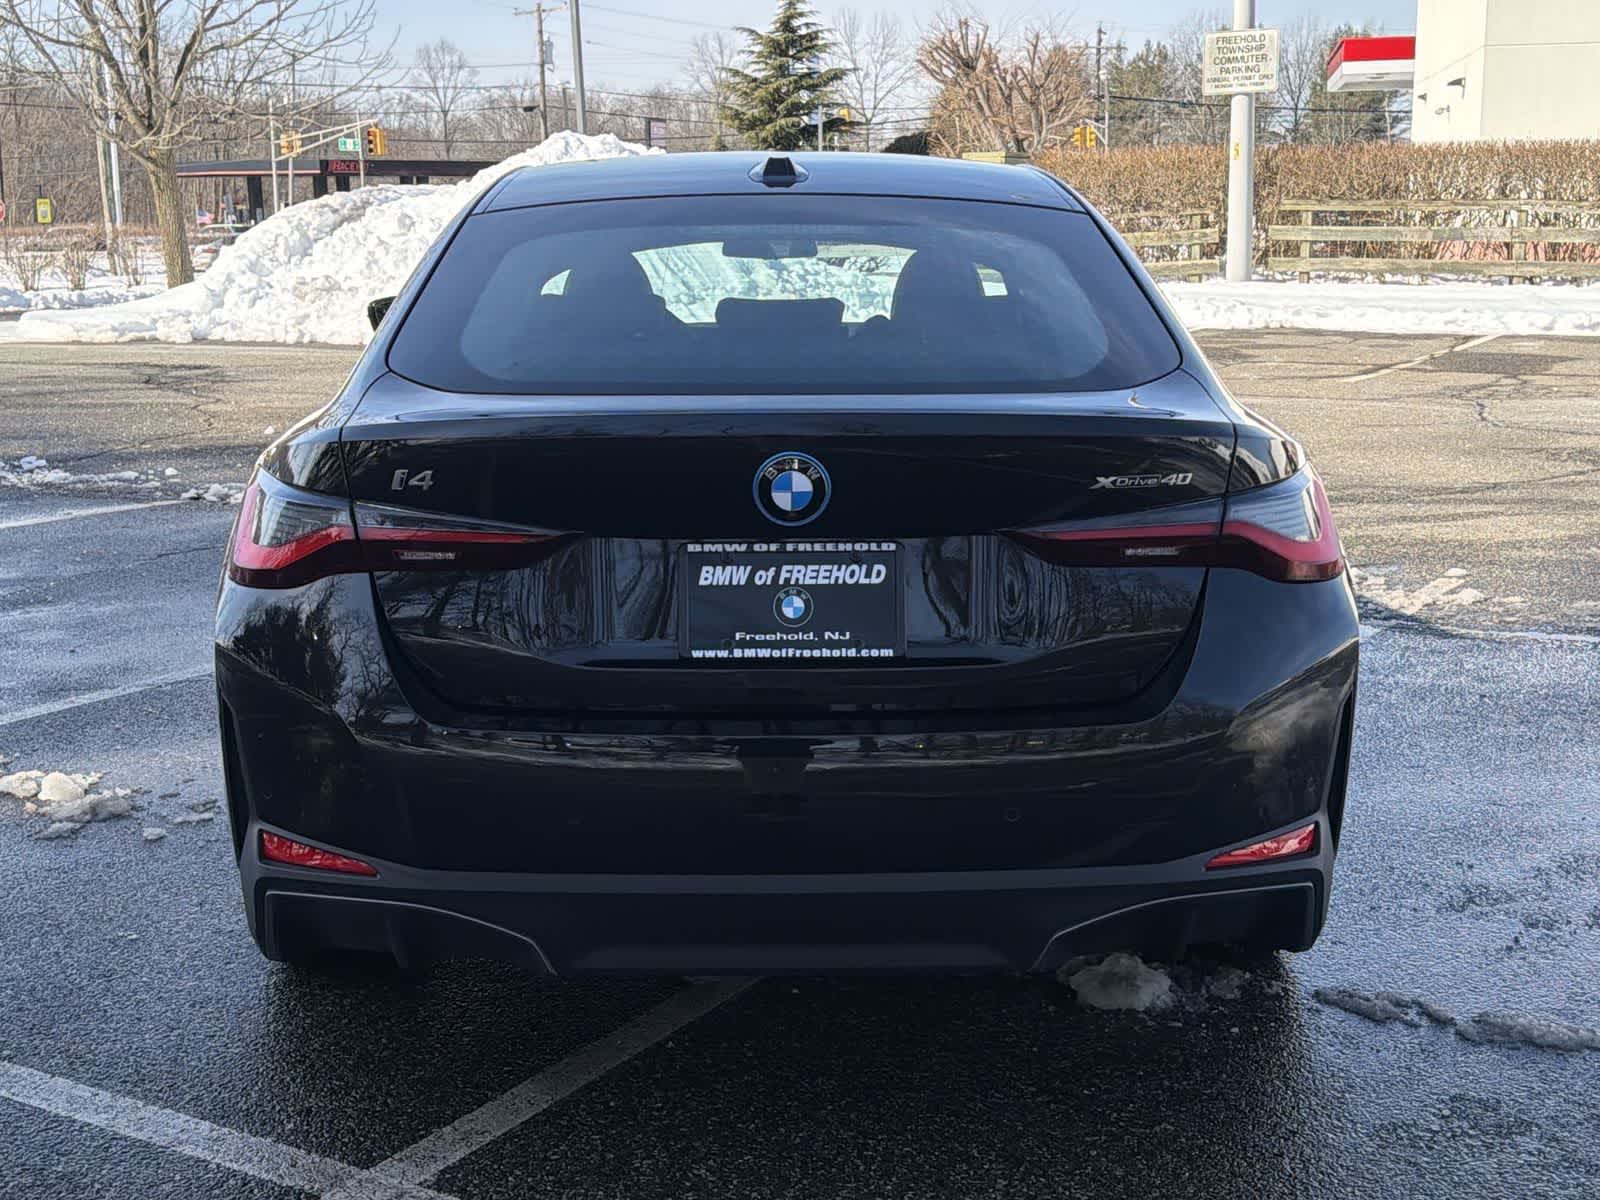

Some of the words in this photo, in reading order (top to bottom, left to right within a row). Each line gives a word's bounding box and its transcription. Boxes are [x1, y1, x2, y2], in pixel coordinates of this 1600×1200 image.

[1216, 33, 1266, 45] FREEHOLD
[1216, 43, 1266, 55] TOWNSHIP
[1213, 53, 1268, 65] COMMUTER
[1219, 64, 1261, 75] PARKING
[764, 458, 821, 481] BMW
[391, 469, 433, 491] i4
[687, 543, 748, 552] BMW
[753, 543, 781, 551] OF
[786, 542, 897, 552] FREEHOLD
[698, 565, 752, 586] BMW
[754, 567, 776, 585] of
[778, 564, 887, 585] FREEHOLD
[735, 632, 818, 641] Freehold,
[824, 632, 851, 641] NJ
[691, 648, 894, 658] www.BMWofFreehold.com
